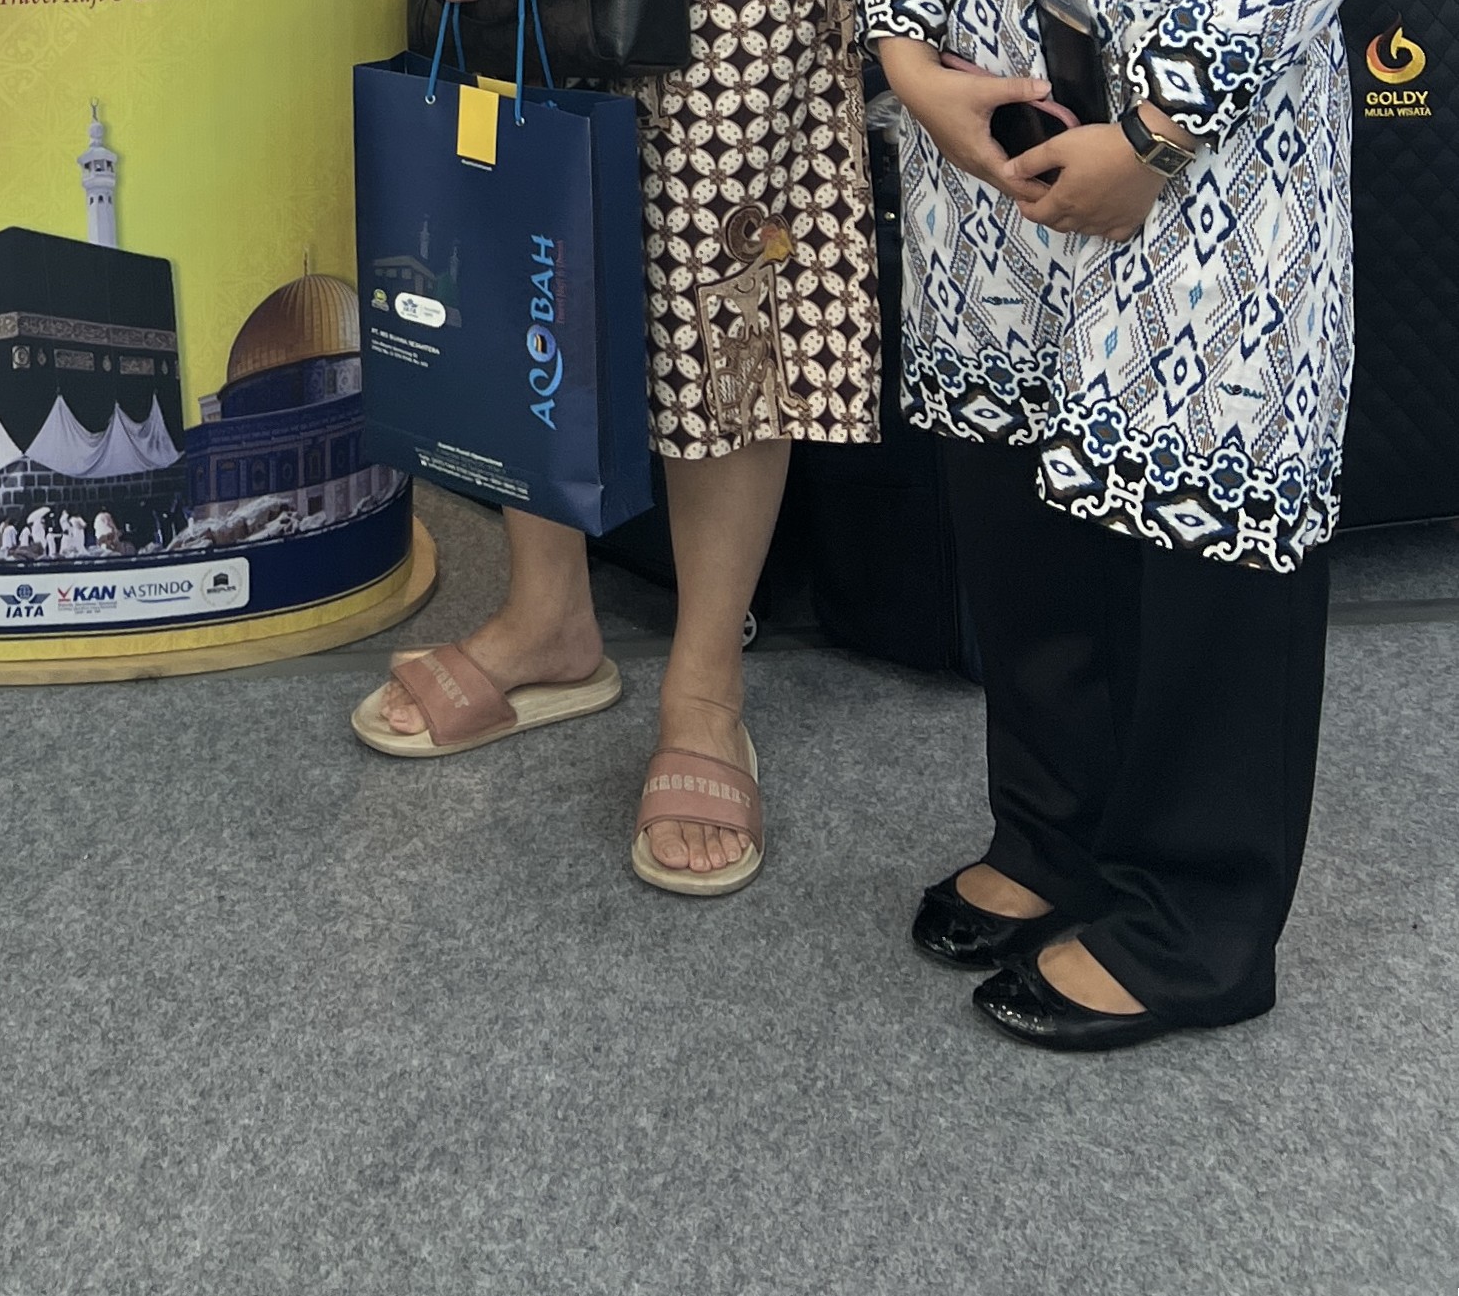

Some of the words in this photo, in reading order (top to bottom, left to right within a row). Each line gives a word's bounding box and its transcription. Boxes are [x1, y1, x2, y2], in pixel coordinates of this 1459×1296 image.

[1365, 90, 1429, 105] GOLDY
[1364, 107, 1395, 118] MULIA
[1396, 106, 1432, 117] WISATA
[525, 233, 564, 431] AQOBAH
[72, 584, 117, 602] KAN
[5, 606, 45, 619] IATA
